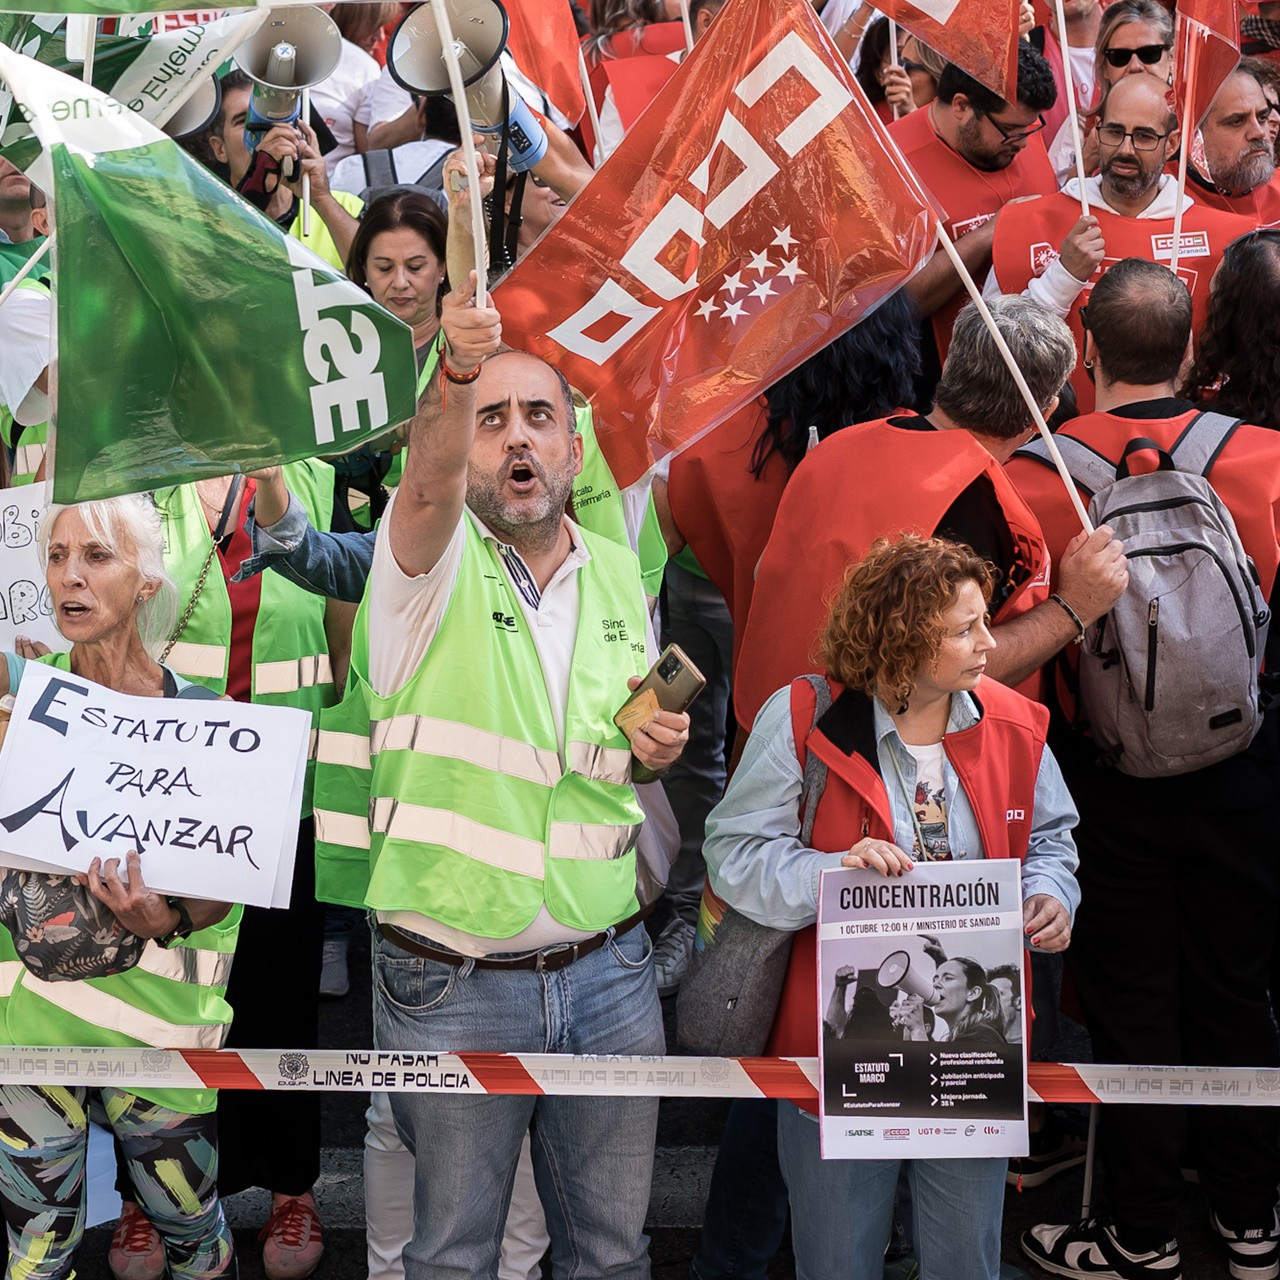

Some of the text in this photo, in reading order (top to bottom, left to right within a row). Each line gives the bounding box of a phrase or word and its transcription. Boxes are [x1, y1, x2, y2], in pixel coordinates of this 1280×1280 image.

[105, 761, 201, 797] PARA
[840, 877, 1000, 910] CONCENTRACIÓN
[840, 926, 844, 935] 1
[846, 923, 878, 935] OCTUBRE
[881, 923, 901, 933] 12:00
[902, 922, 908, 932] H
[916, 919, 957, 931] MINISTERIO
[958, 918, 968, 928] DE
[969, 916, 1001, 928] SANIDAD
[854, 1062, 890, 1073] ESTATUTO
[312, 1070, 470, 1088] LINEA DE POLICIA
[859, 1073, 885, 1083] MARCO
[848, 1129, 874, 1137] SATSE
